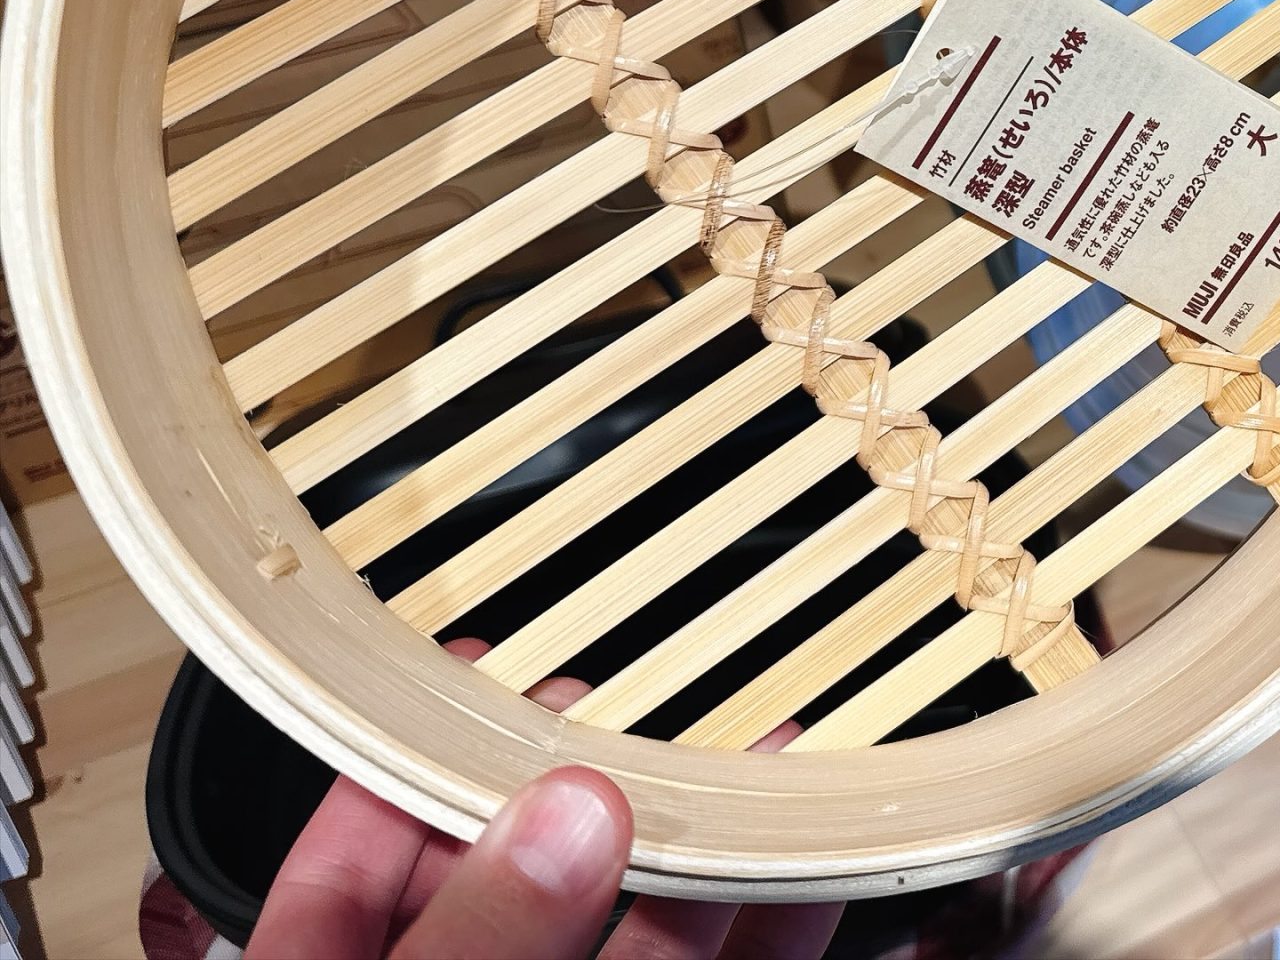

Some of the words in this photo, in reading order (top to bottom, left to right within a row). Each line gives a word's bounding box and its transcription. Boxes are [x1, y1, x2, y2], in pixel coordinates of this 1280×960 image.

[928, 149, 957, 180] 竹材
[1247, 125, 1278, 156] 大
[992, 170, 1035, 218] 深型
[1023, 174, 1064, 229] Steamer
[1059, 128, 1097, 174] basket
[1082, 139, 1170, 260] です。茶碗蒸しなども入る
[1099, 174, 1174, 271] 深型に仕上げました。
[1182, 281, 1218, 318] MUJI
[1211, 232, 1254, 281] 無印良品
[1223, 302, 1254, 337] 消費税込
